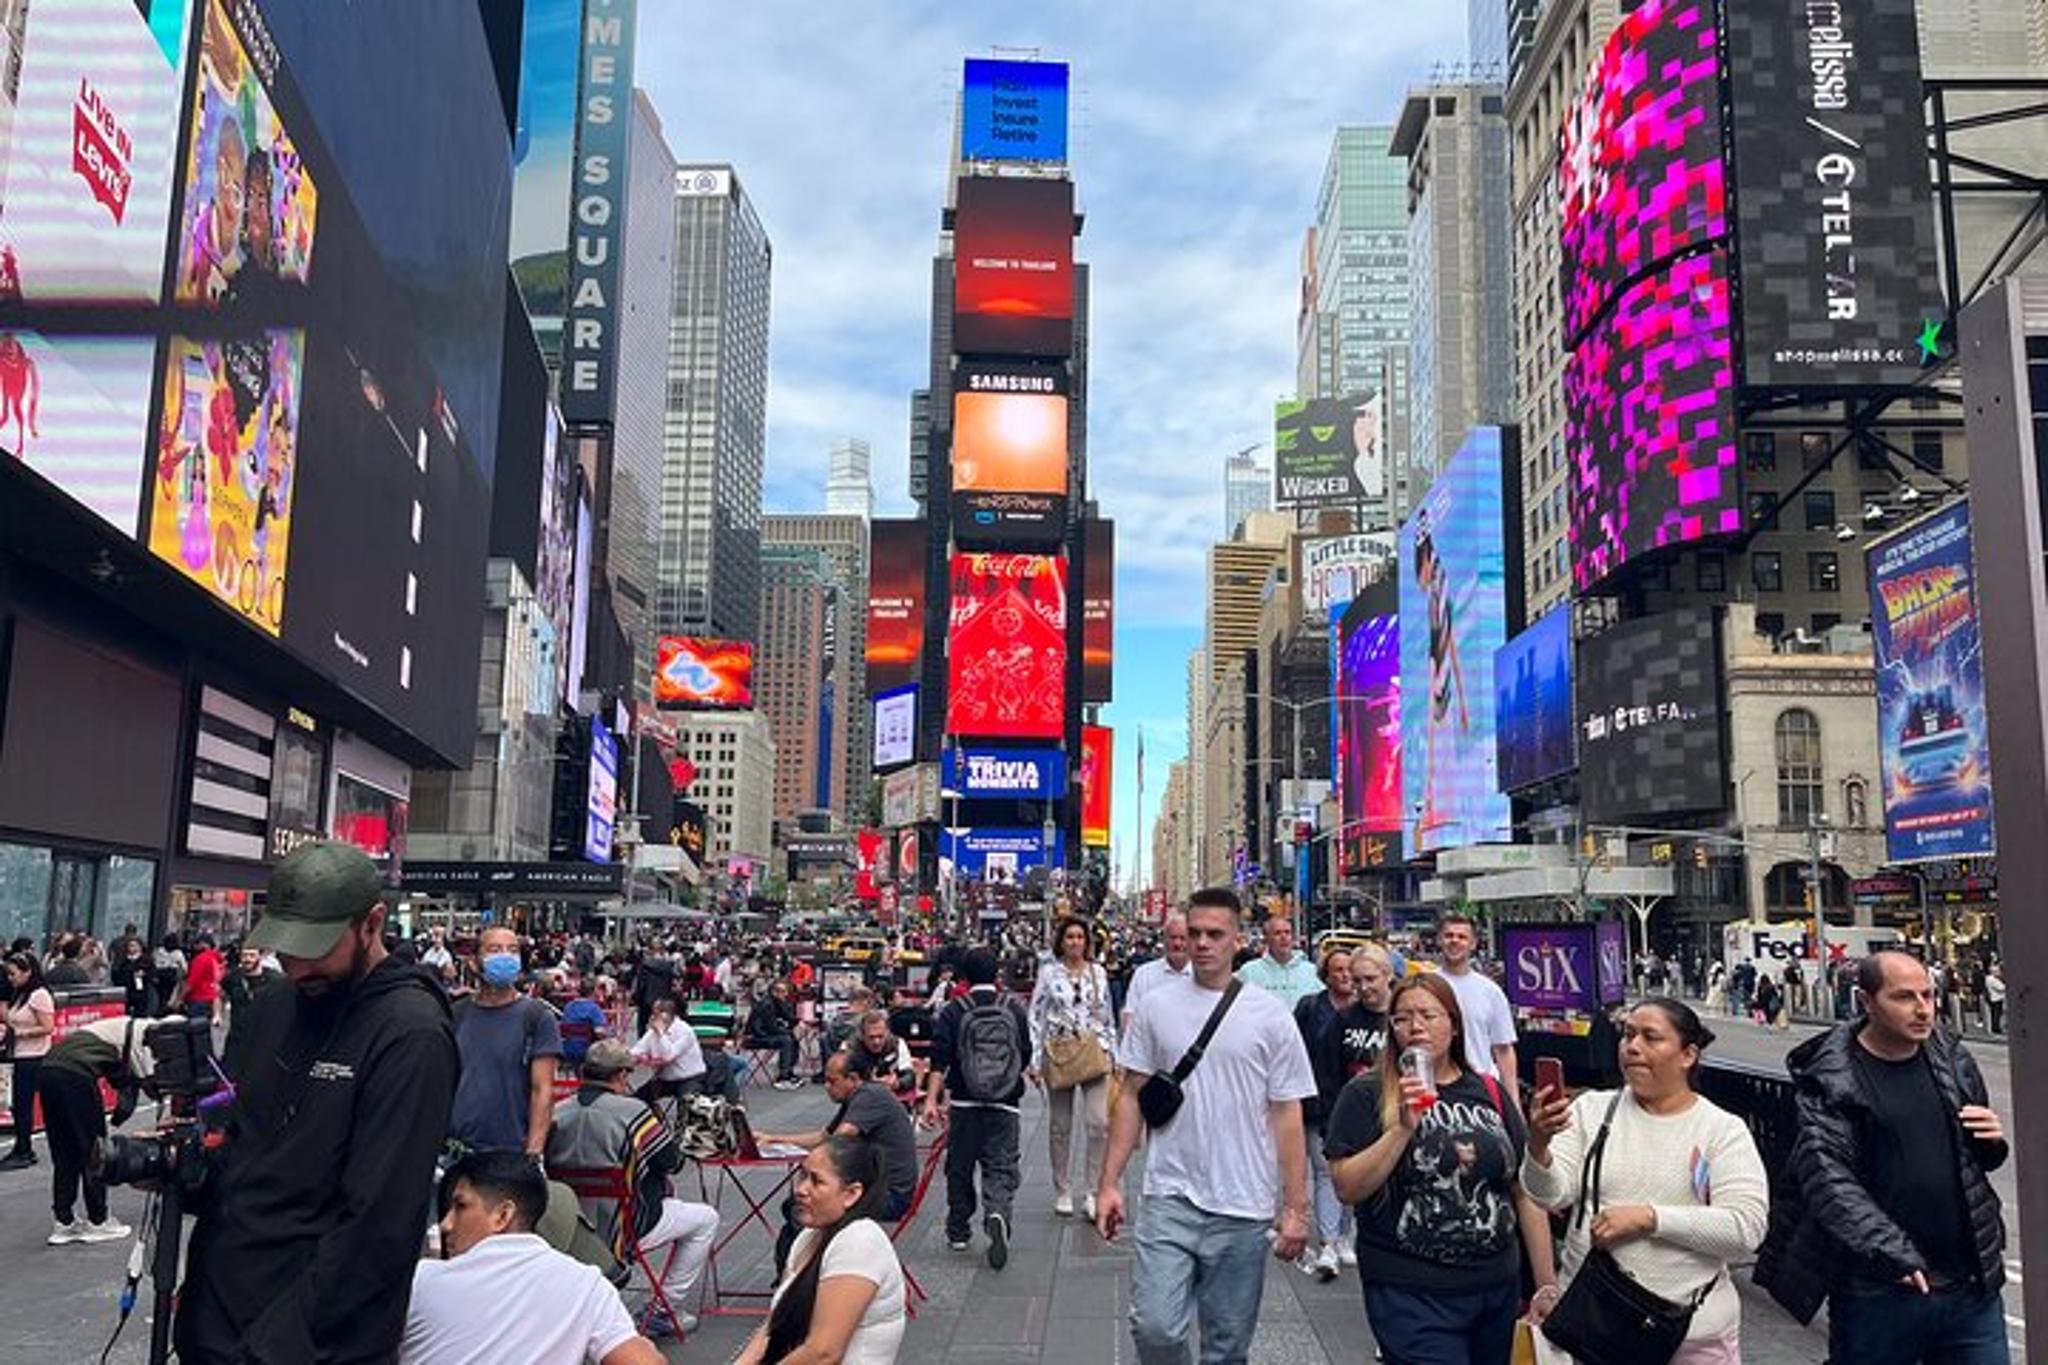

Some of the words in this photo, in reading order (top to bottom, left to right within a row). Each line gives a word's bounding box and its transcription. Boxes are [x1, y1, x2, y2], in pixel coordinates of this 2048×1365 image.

[585, 0, 621, 124] MES
[1806, 0, 1853, 109] melissa
[992, 92, 1039, 109] Invest
[992, 109, 1040, 126] Insure
[992, 127, 1038, 143] Retire
[573, 155, 612, 391] SQUARE
[972, 258, 1007, 270] WELCOME
[1008, 259, 1020, 271] TO
[1020, 260, 1057, 272] THAILAND
[969, 374, 1054, 391] SAMSUNG
[1310, 537, 1355, 567] LITTLE
[968, 761, 1040, 780] TRIVIA
